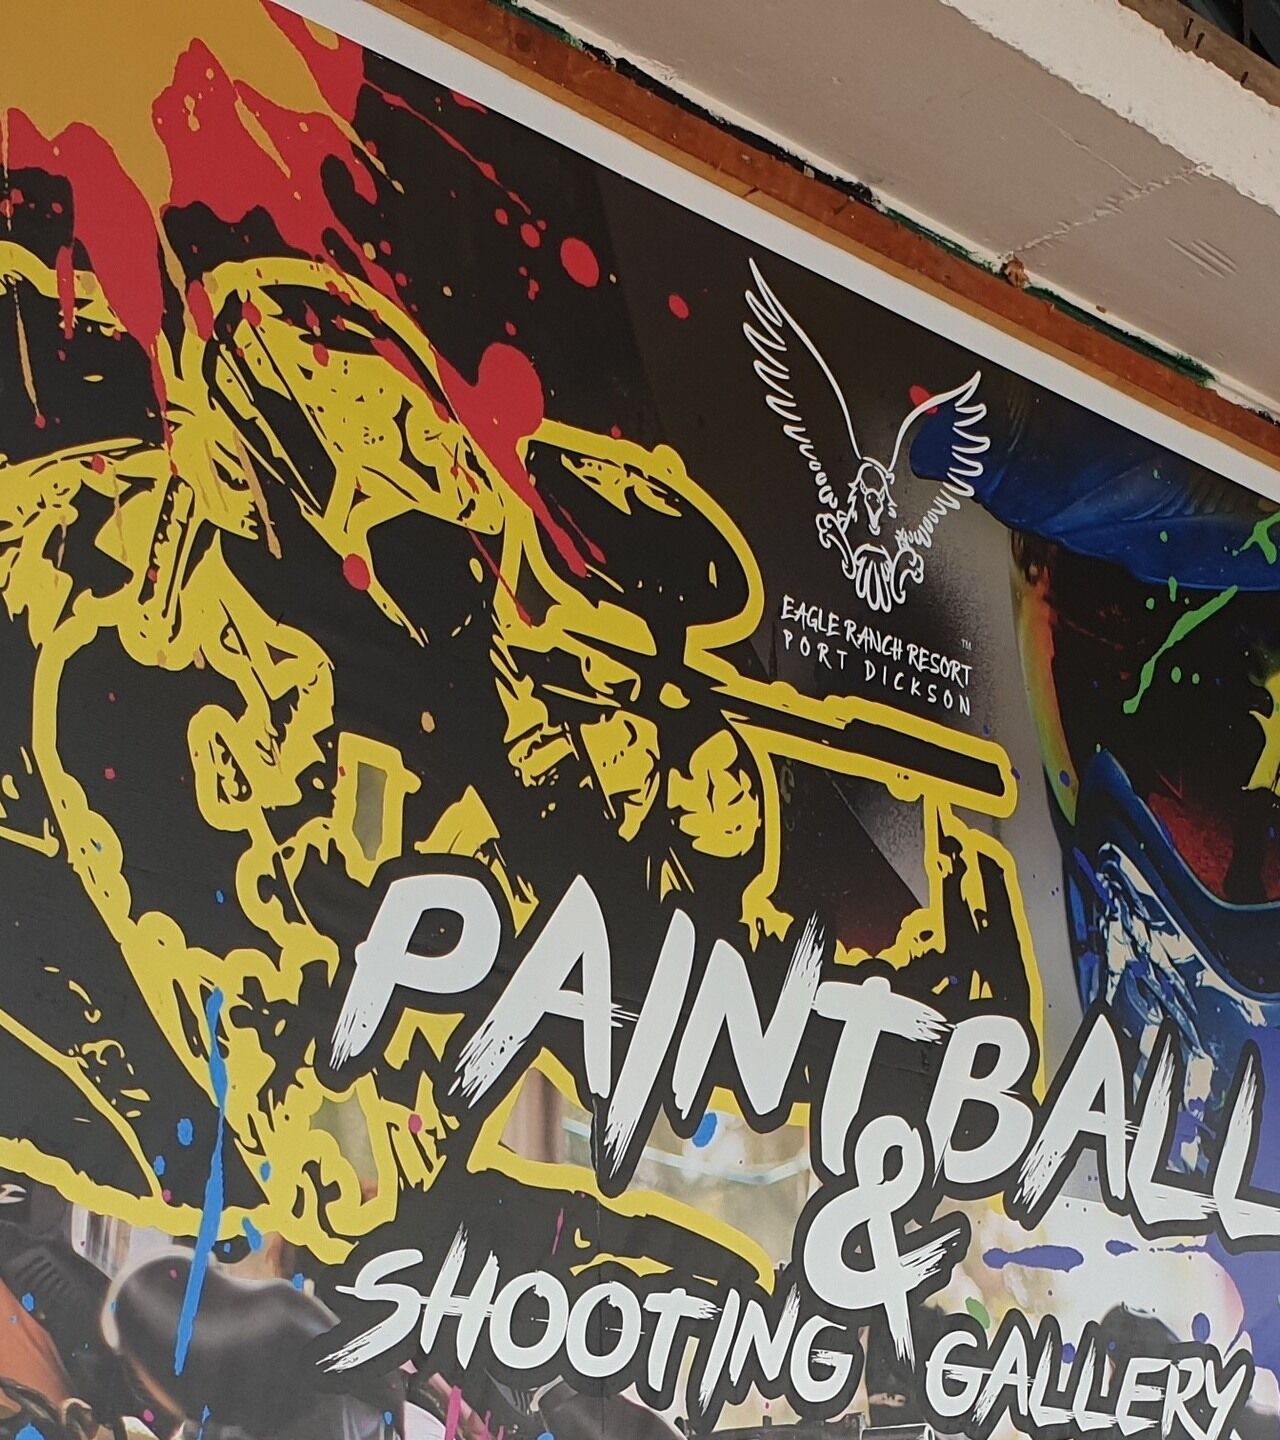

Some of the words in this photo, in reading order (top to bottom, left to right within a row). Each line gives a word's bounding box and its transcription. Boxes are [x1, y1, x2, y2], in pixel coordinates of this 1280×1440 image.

[781, 594, 840, 636] EAGLE
[844, 619, 903, 661] RANCH
[907, 643, 972, 688] RESORT
[783, 629, 848, 669] PORT
[864, 660, 970, 716] DICKSON
[316, 1222, 856, 1415] SHOOTING
